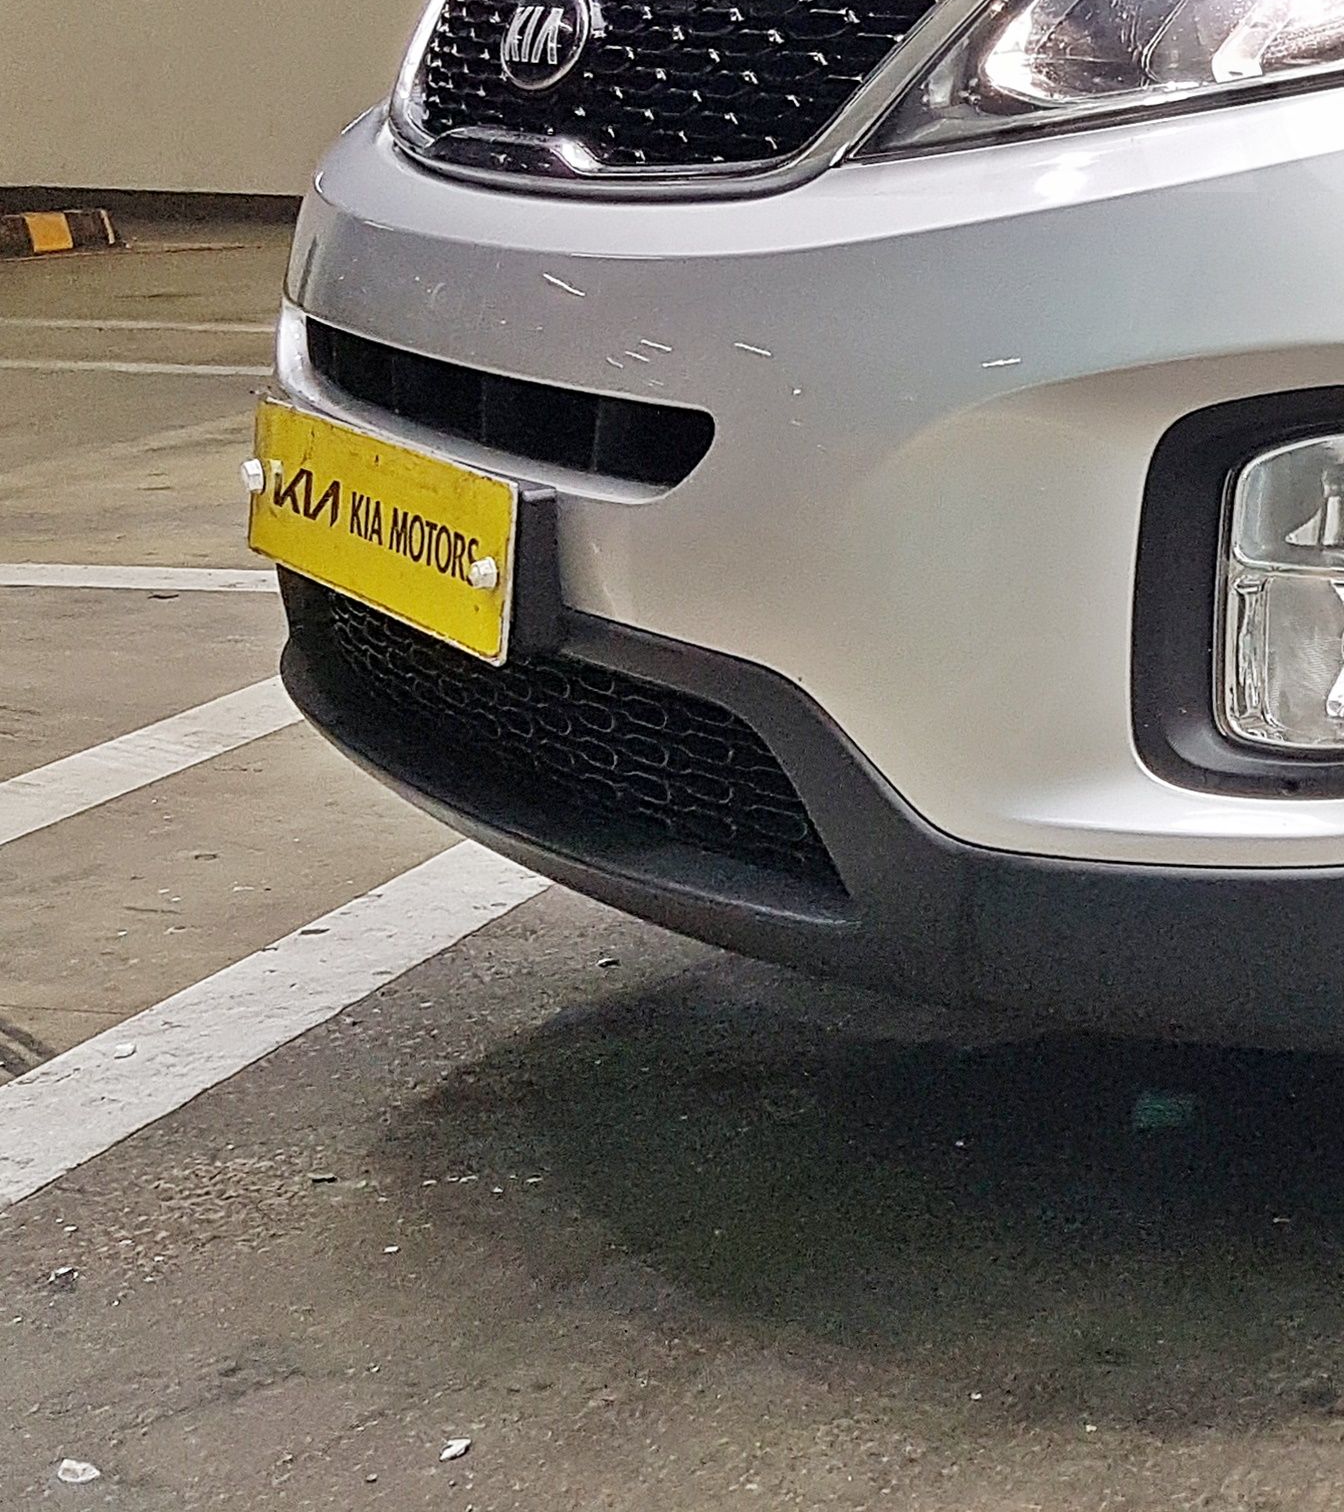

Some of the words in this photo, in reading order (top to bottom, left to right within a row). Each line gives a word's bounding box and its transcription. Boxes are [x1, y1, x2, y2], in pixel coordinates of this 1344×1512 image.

[504, 5, 565, 65] KIA
[350, 491, 383, 546] KIA
[388, 507, 480, 586] MOTORS
